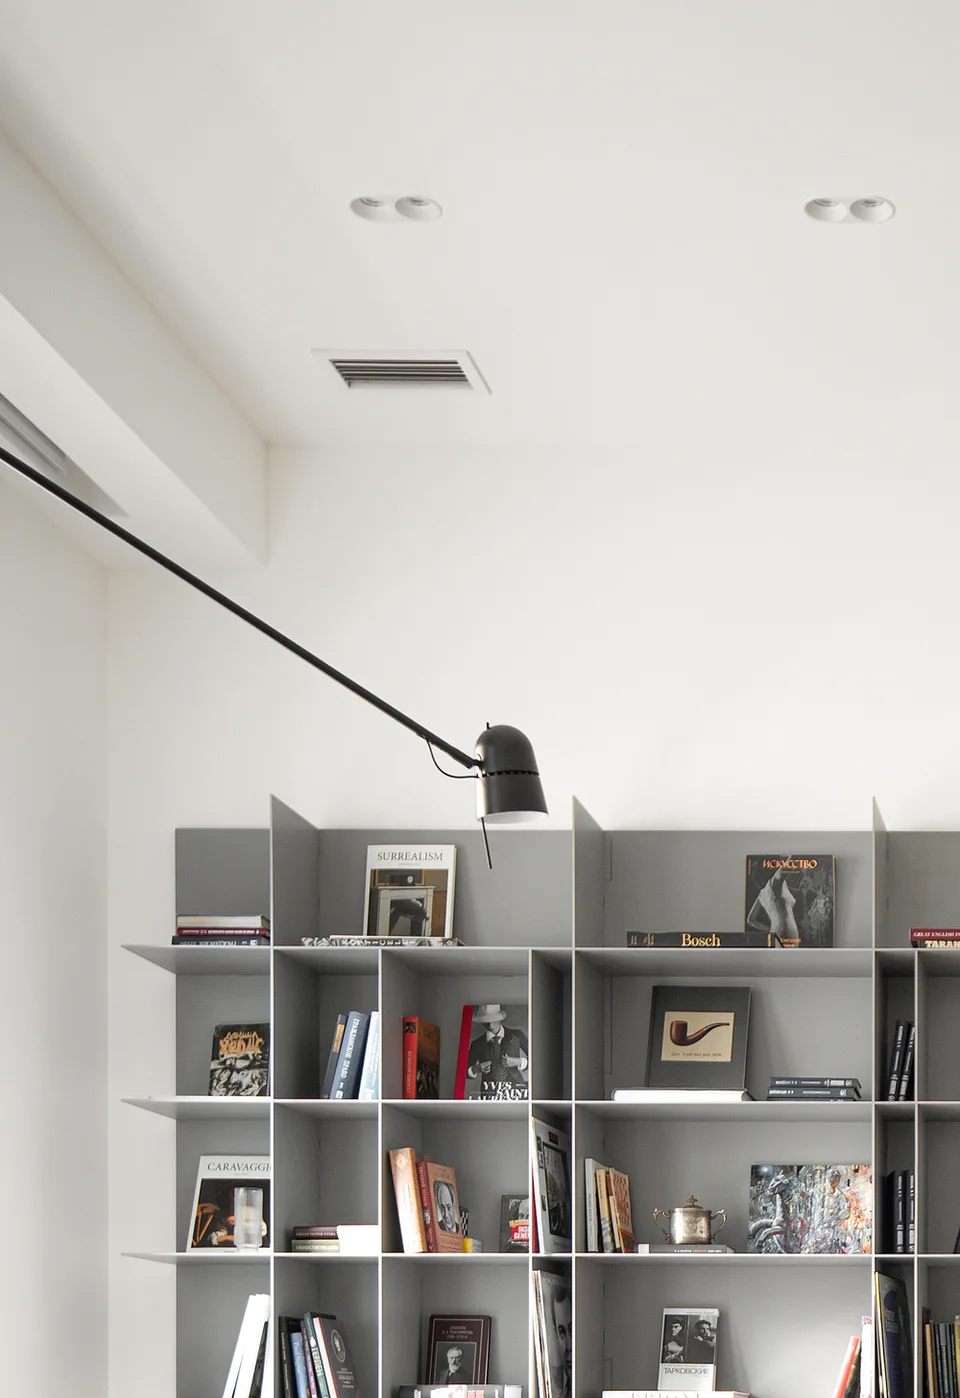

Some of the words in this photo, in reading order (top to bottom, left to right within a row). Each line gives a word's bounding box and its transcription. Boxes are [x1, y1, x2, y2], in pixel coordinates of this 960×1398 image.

[377, 851, 443, 861] SURREALISM
[762, 859, 819, 869] ИСКУССТВО
[681, 933, 721, 947] Bosch
[483, 1081, 513, 1091] YVES
[663, 1367, 709, 1375] ТАРКОВСКИЕ
